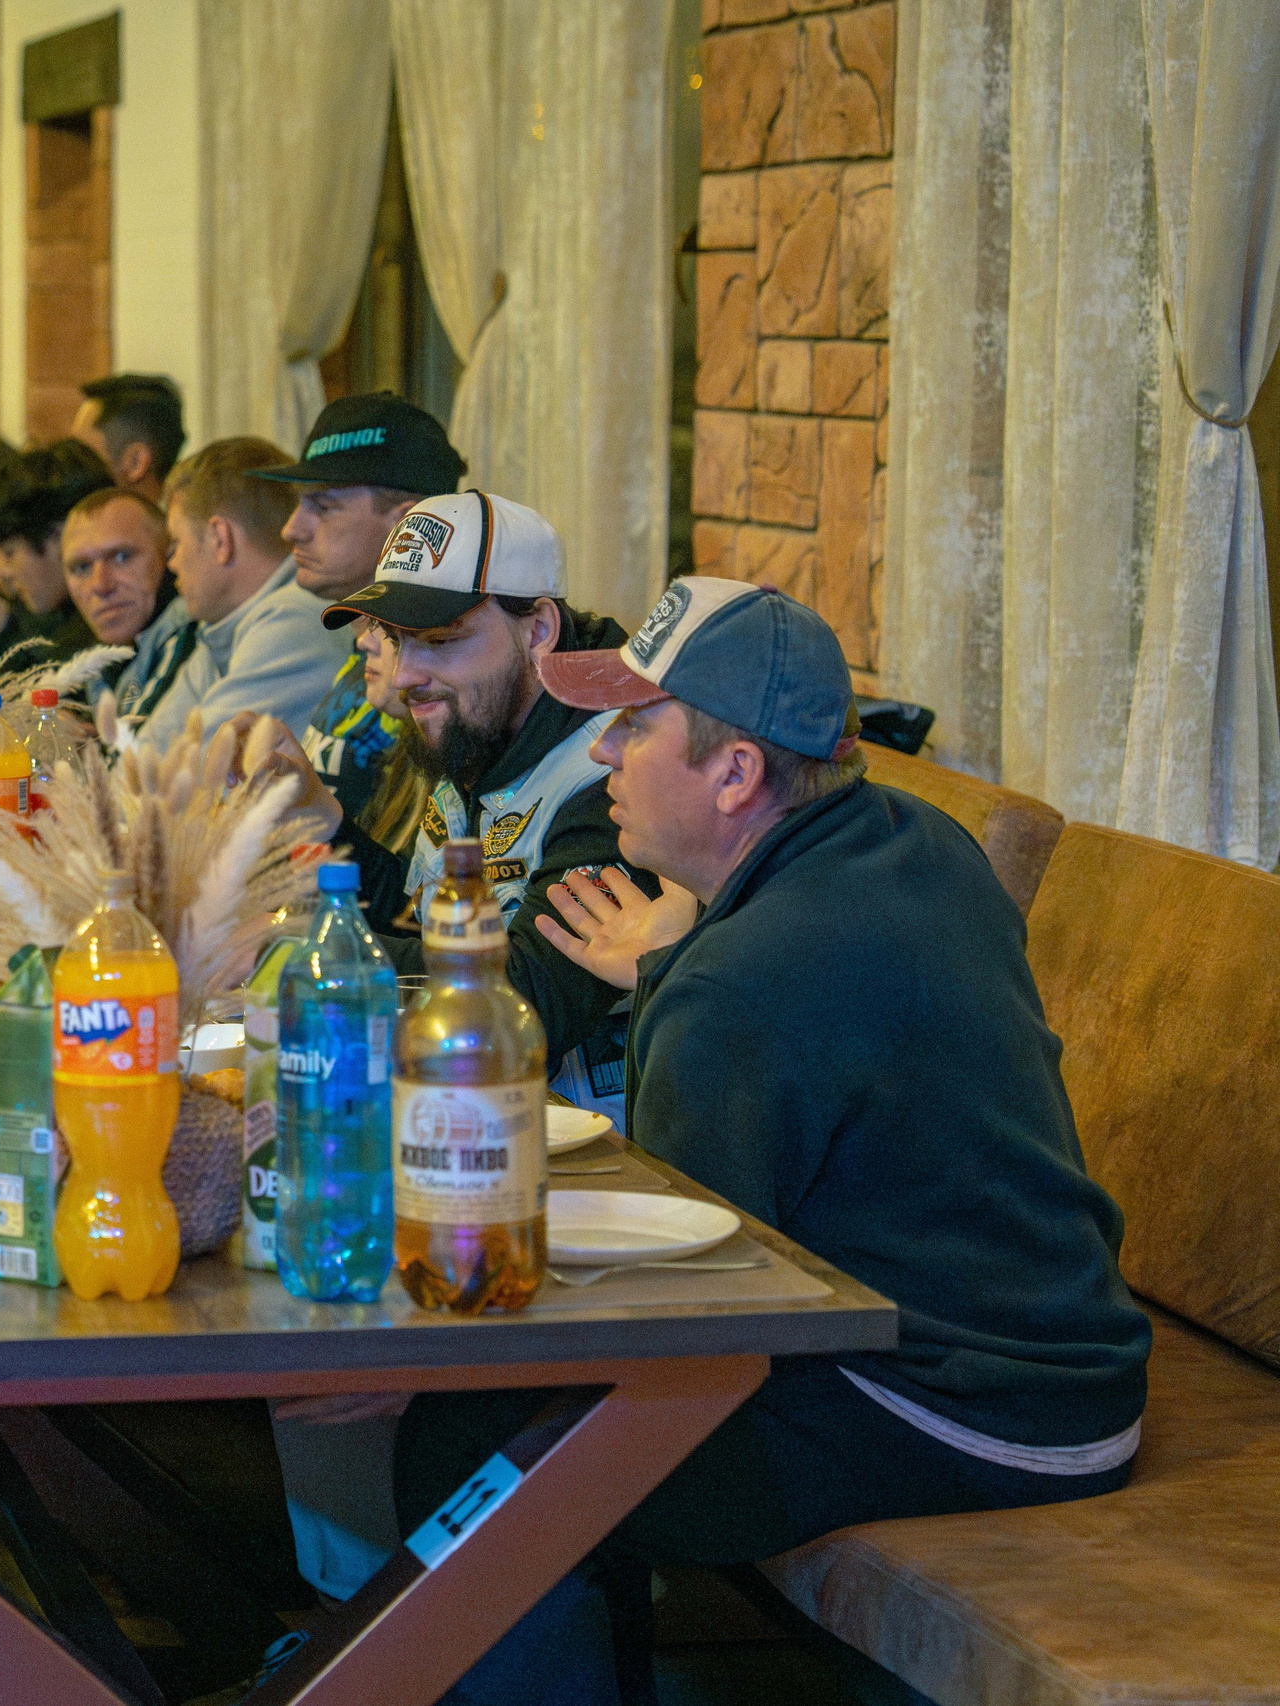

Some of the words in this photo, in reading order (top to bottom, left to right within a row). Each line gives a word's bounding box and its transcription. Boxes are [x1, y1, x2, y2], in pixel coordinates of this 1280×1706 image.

[396, 515, 449, 554] DAVIDSON
[383, 560, 420, 572] RCYCLES
[60, 1001, 132, 1034] FANTA
[278, 1050, 337, 1080] amily
[248, 1164, 280, 1199] DE
